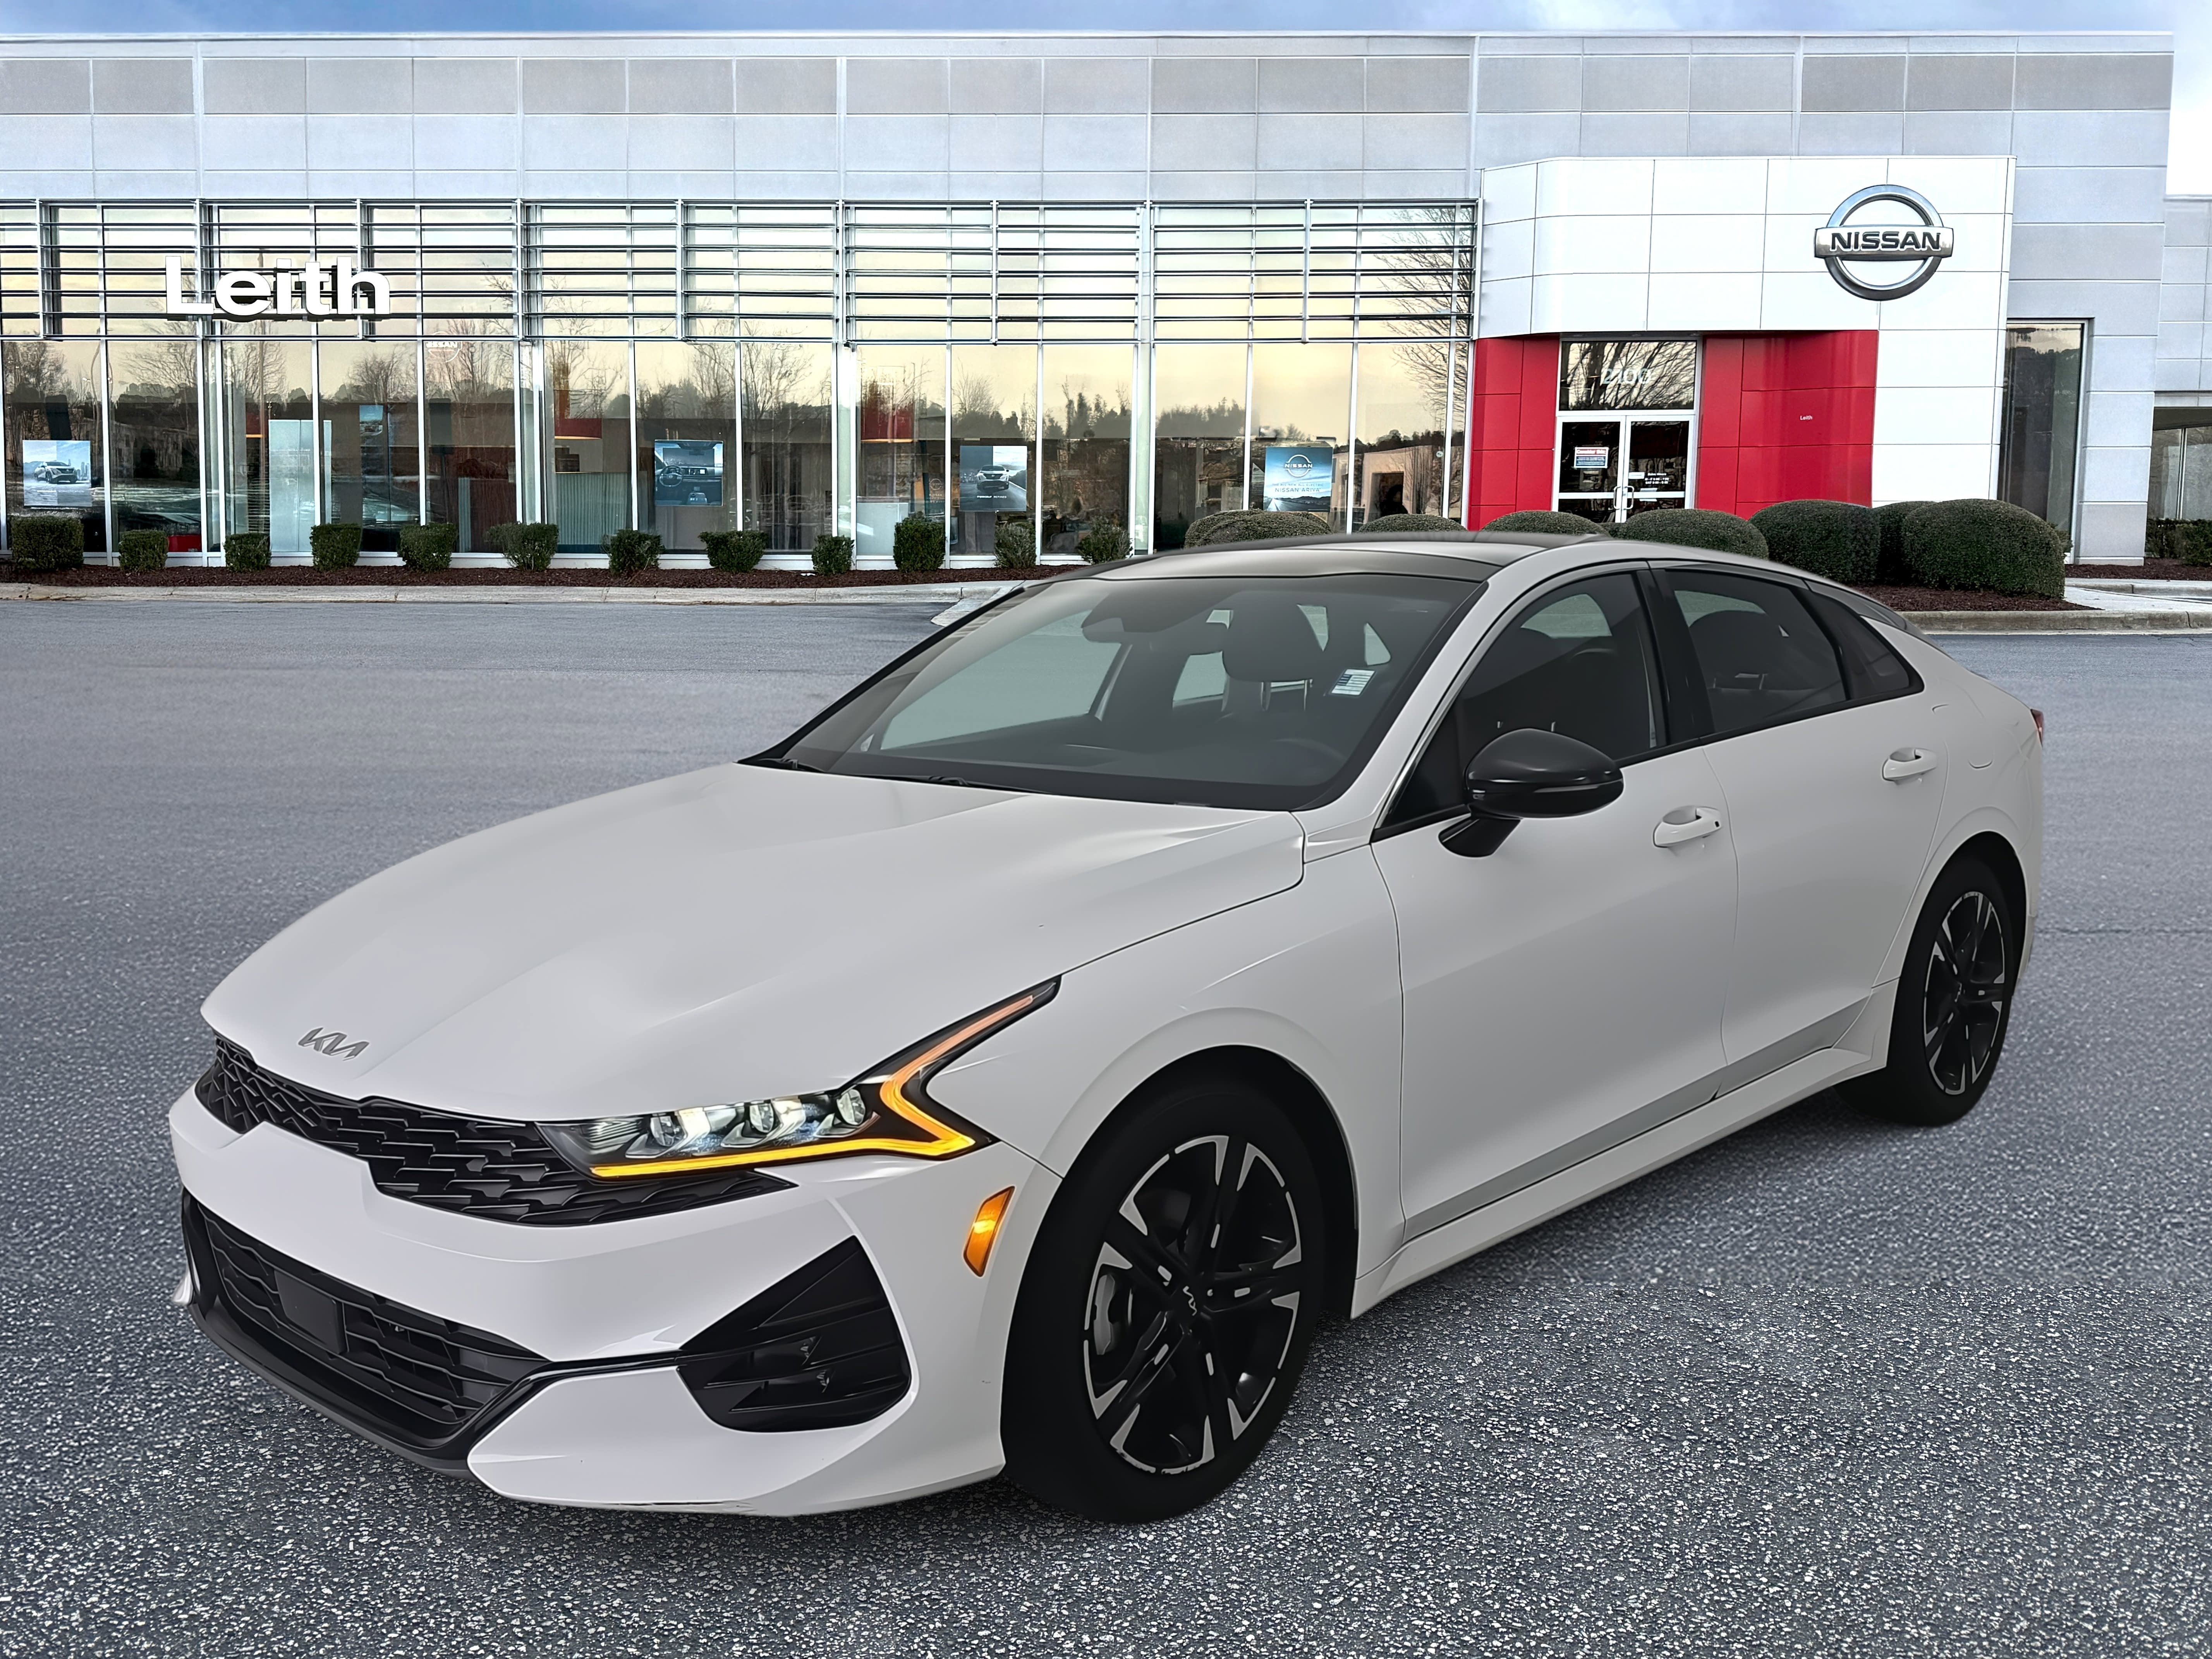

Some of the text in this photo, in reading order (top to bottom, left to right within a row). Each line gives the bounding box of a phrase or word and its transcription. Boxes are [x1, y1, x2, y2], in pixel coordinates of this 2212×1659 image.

[1831, 232, 1941, 251] NISSAN
[165, 256, 390, 316] Leith
[298, 1027, 369, 1061] KIA
